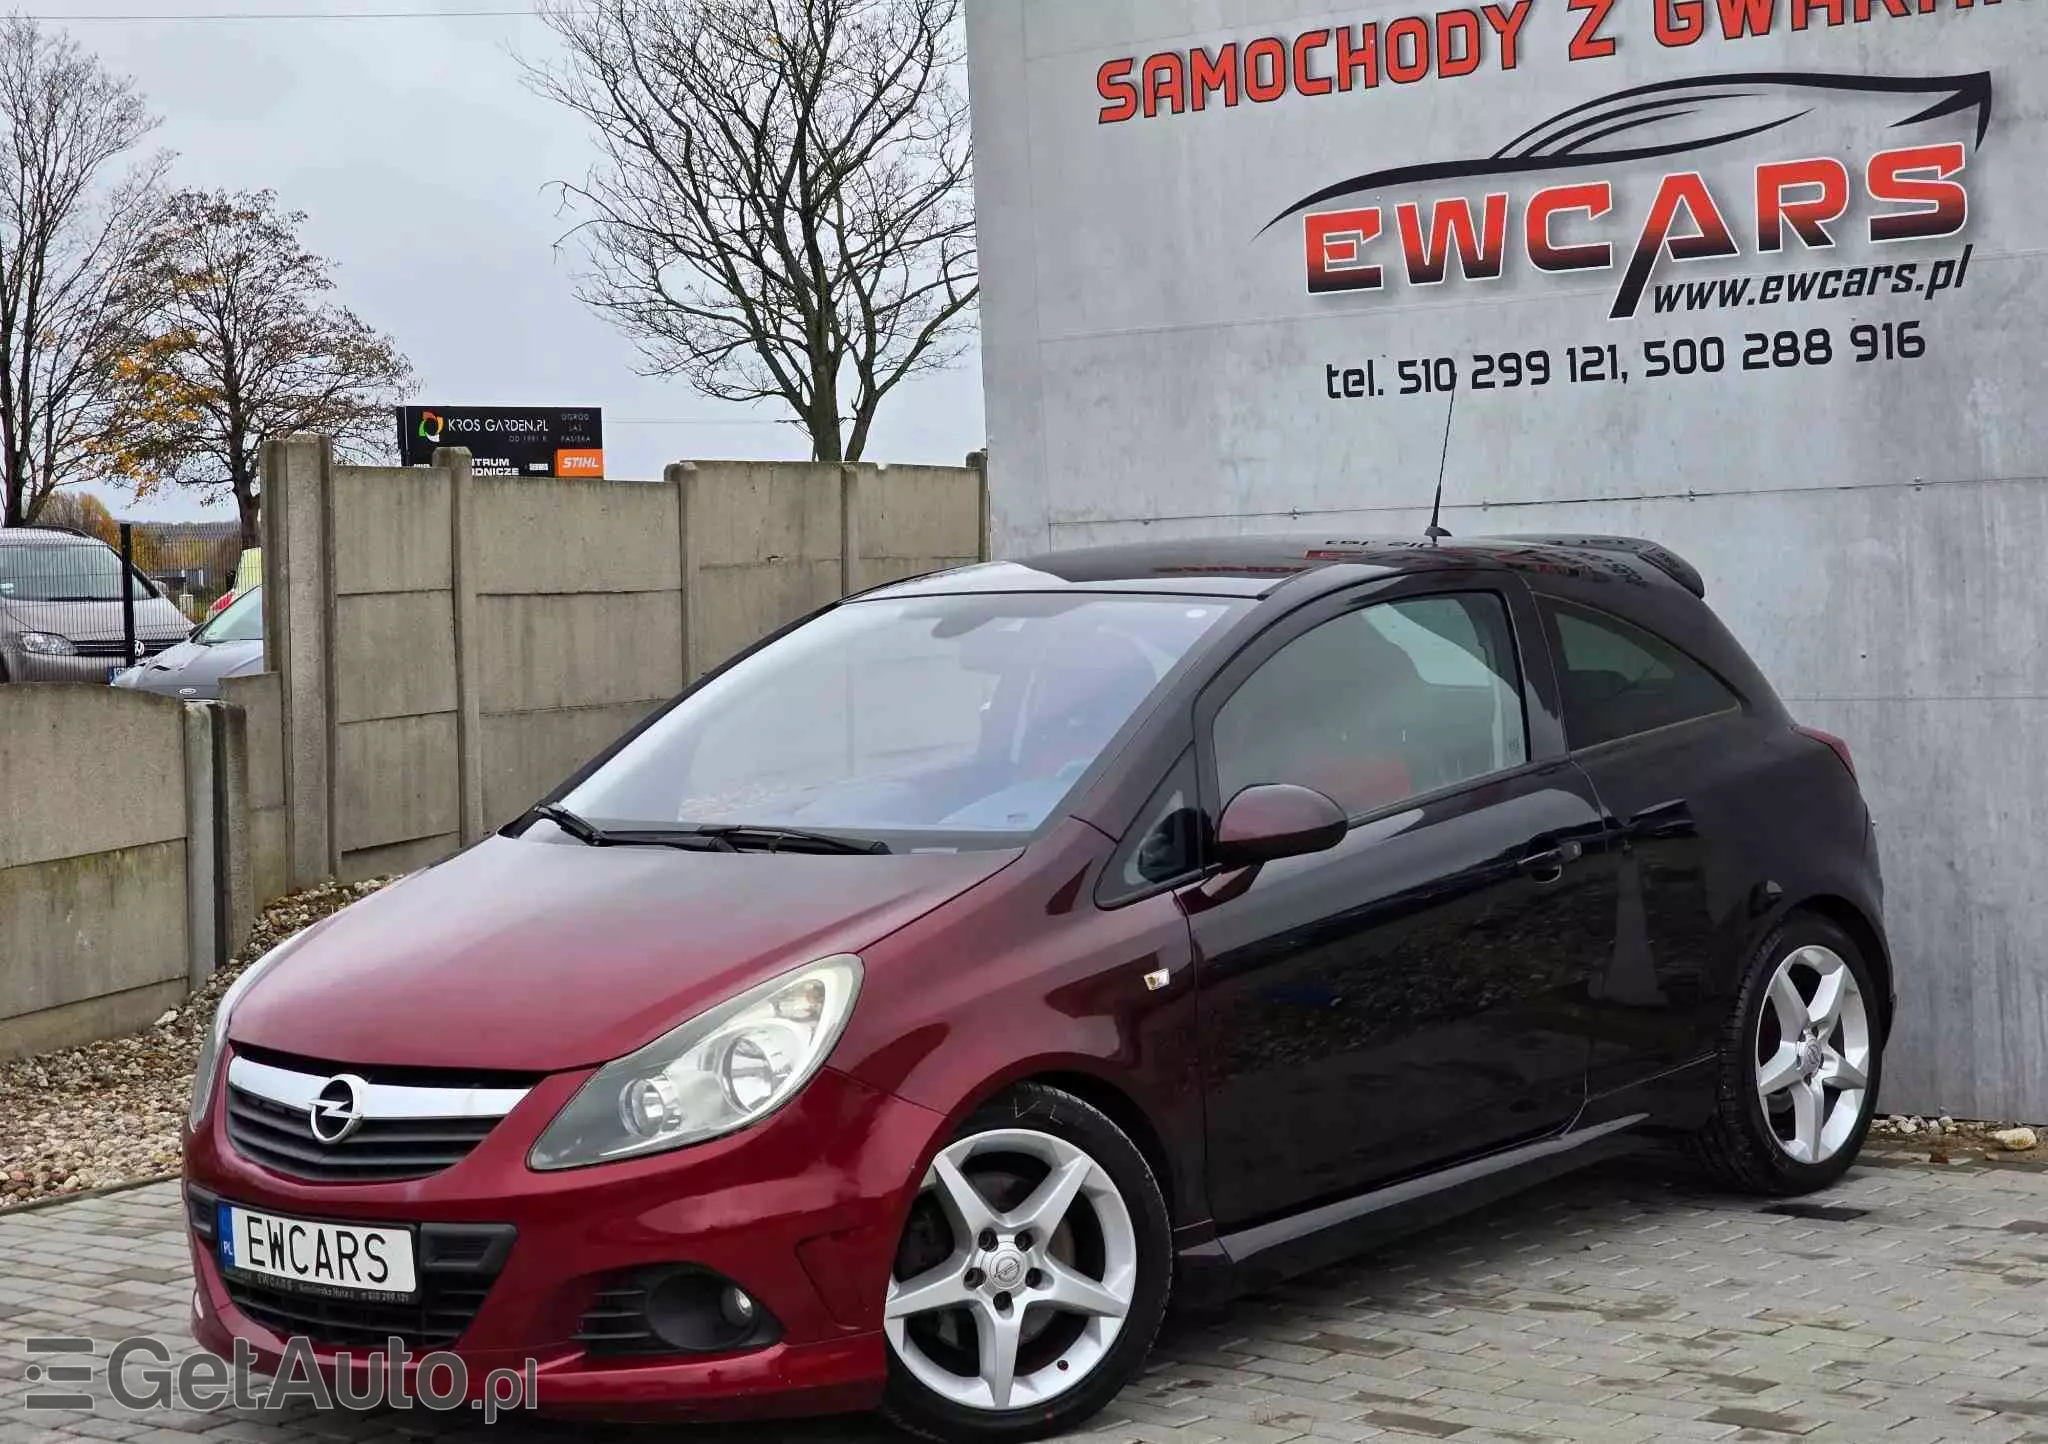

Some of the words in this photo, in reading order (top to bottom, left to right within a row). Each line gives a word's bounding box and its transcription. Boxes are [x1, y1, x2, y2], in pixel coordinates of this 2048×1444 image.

[1096, 0, 1531, 124] SAMOCHODY
[1567, 0, 1616, 61] Z
[1303, 142, 1968, 319] EWCARS
[1653, 244, 1974, 313] www.ewcars.pl
[1326, 359, 1384, 399] tel.
[1398, 356, 1458, 395] 510
[1471, 350, 1550, 390] 299
[1566, 344, 1628, 385] 121,
[1643, 336, 1725, 377] 500
[1742, 328, 1833, 370] 288
[1850, 320, 1926, 362] 916
[448, 418, 481, 432] KROS
[484, 418, 549, 432] GARDEN.PL
[562, 456, 599, 468] STIHL
[222, 1240, 233, 1256] PL
[246, 1214, 390, 1284] EWCARS
